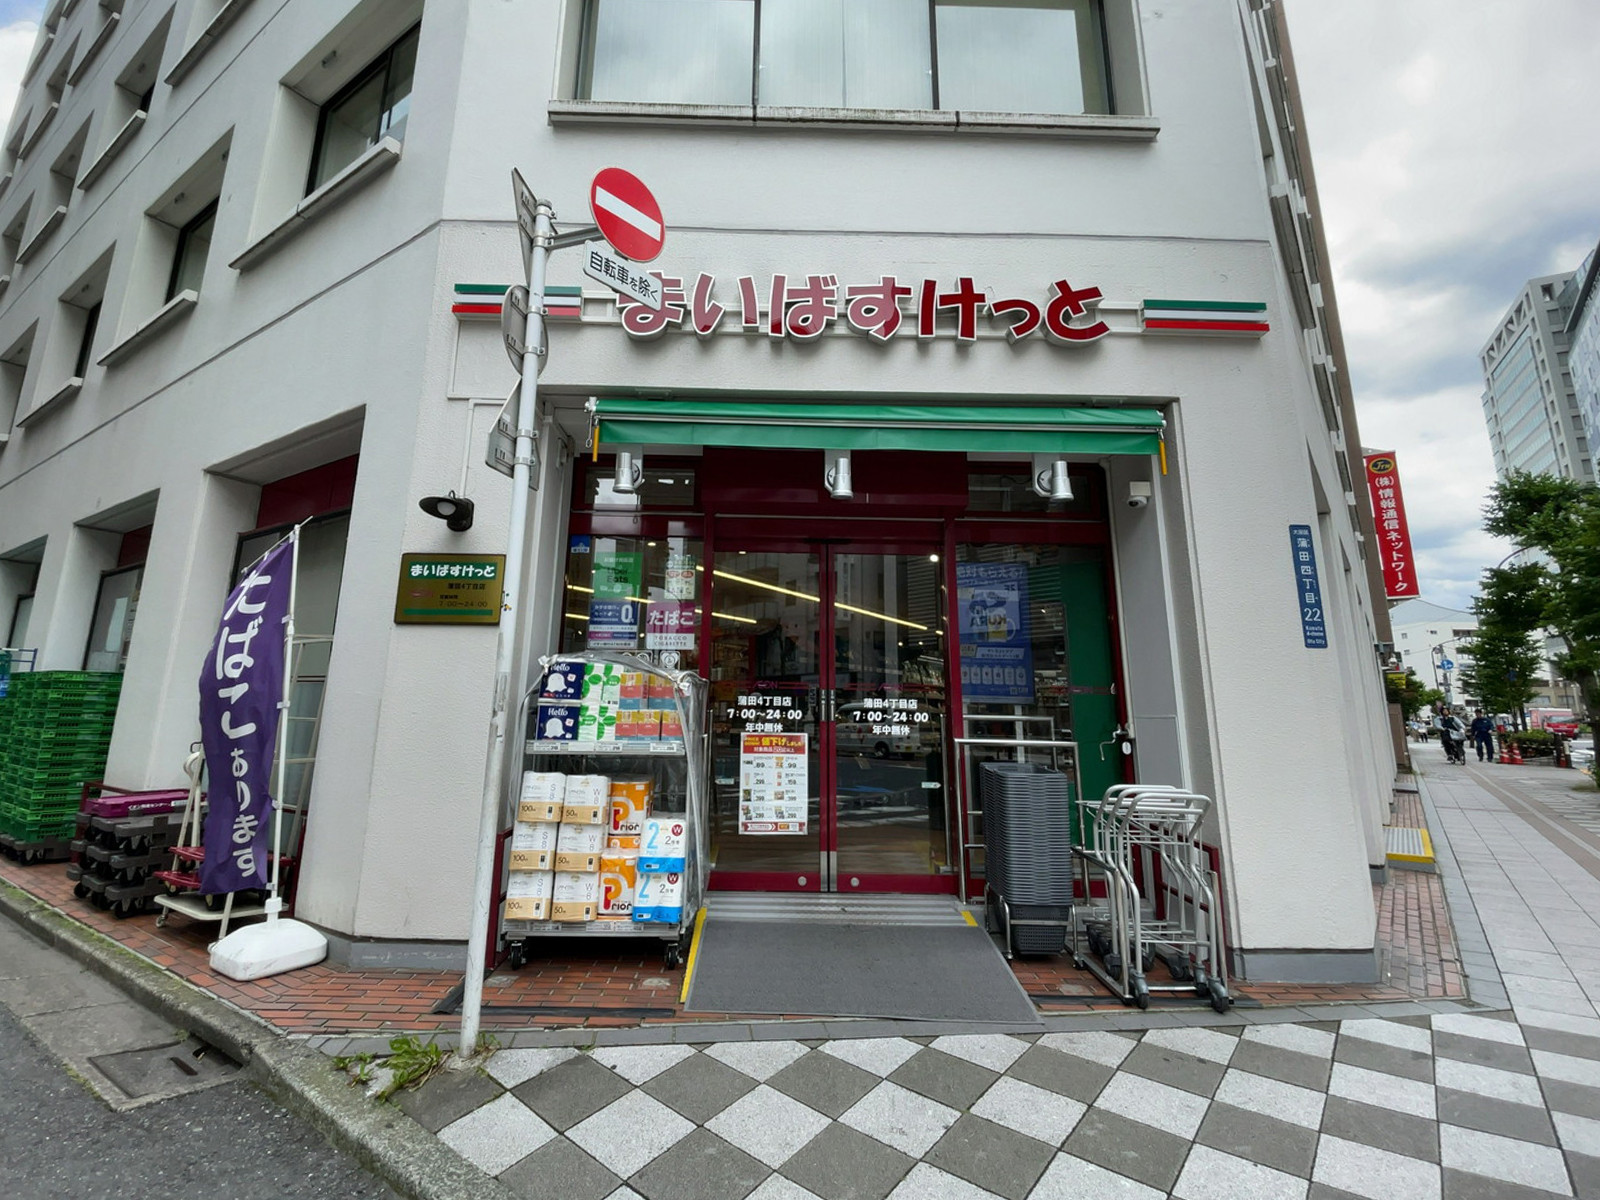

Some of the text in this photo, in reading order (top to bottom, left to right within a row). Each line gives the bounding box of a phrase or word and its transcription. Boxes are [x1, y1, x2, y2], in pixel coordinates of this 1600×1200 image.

[590, 251, 659, 303] 自転車を除く
[616, 271, 1110, 343] まいばすけっと
[411, 565, 495, 577] まいばすけっと
[649, 610, 694, 625] たばこ
[1304, 607, 1321, 622] 22
[737, 696, 792, 707] 蒲田4丁目店
[863, 698, 918, 709] 蒲田4丁目店
[547, 707, 569, 716] Hello
[216, 571, 272, 877] たばこあります
[745, 723, 783, 733] 年中無休
[872, 725, 910, 735] 年中無休
[612, 801, 640, 831] Prior
[647, 821, 660, 849] 2
[638, 873, 651, 898] 2
[603, 877, 632, 910] Prior
